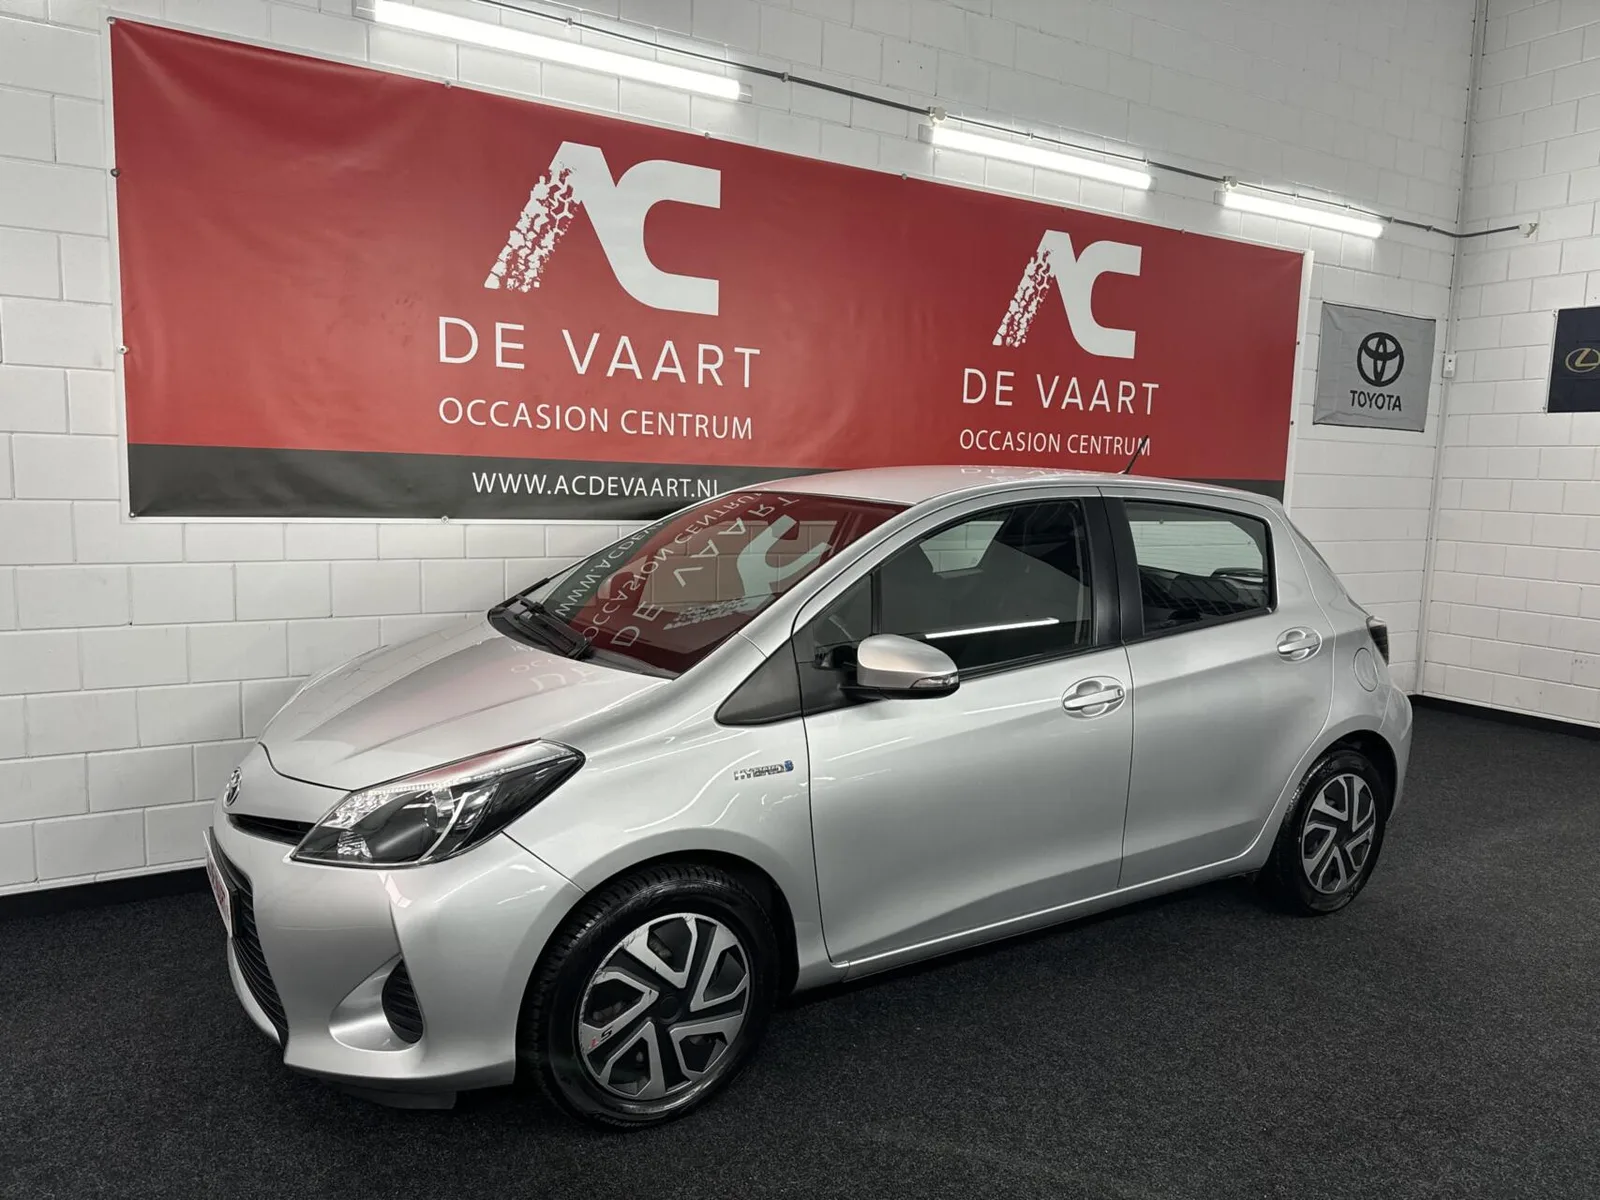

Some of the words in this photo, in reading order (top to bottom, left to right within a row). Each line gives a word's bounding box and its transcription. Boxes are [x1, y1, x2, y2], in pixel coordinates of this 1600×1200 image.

[484, 141, 721, 316] AC
[992, 229, 1142, 359] AC
[438, 316, 525, 370] DE
[562, 329, 761, 388] VAART
[962, 368, 1015, 406] DE
[1036, 373, 1159, 415] VAART
[1350, 390, 1402, 412] TOYOTA
[438, 397, 608, 433] OCCASION
[620, 409, 752, 440] CENTRUM
[959, 429, 1061, 453] OCCASION
[1067, 434, 1150, 456] CENTRUM
[733, 763, 785, 781] HYBRID
